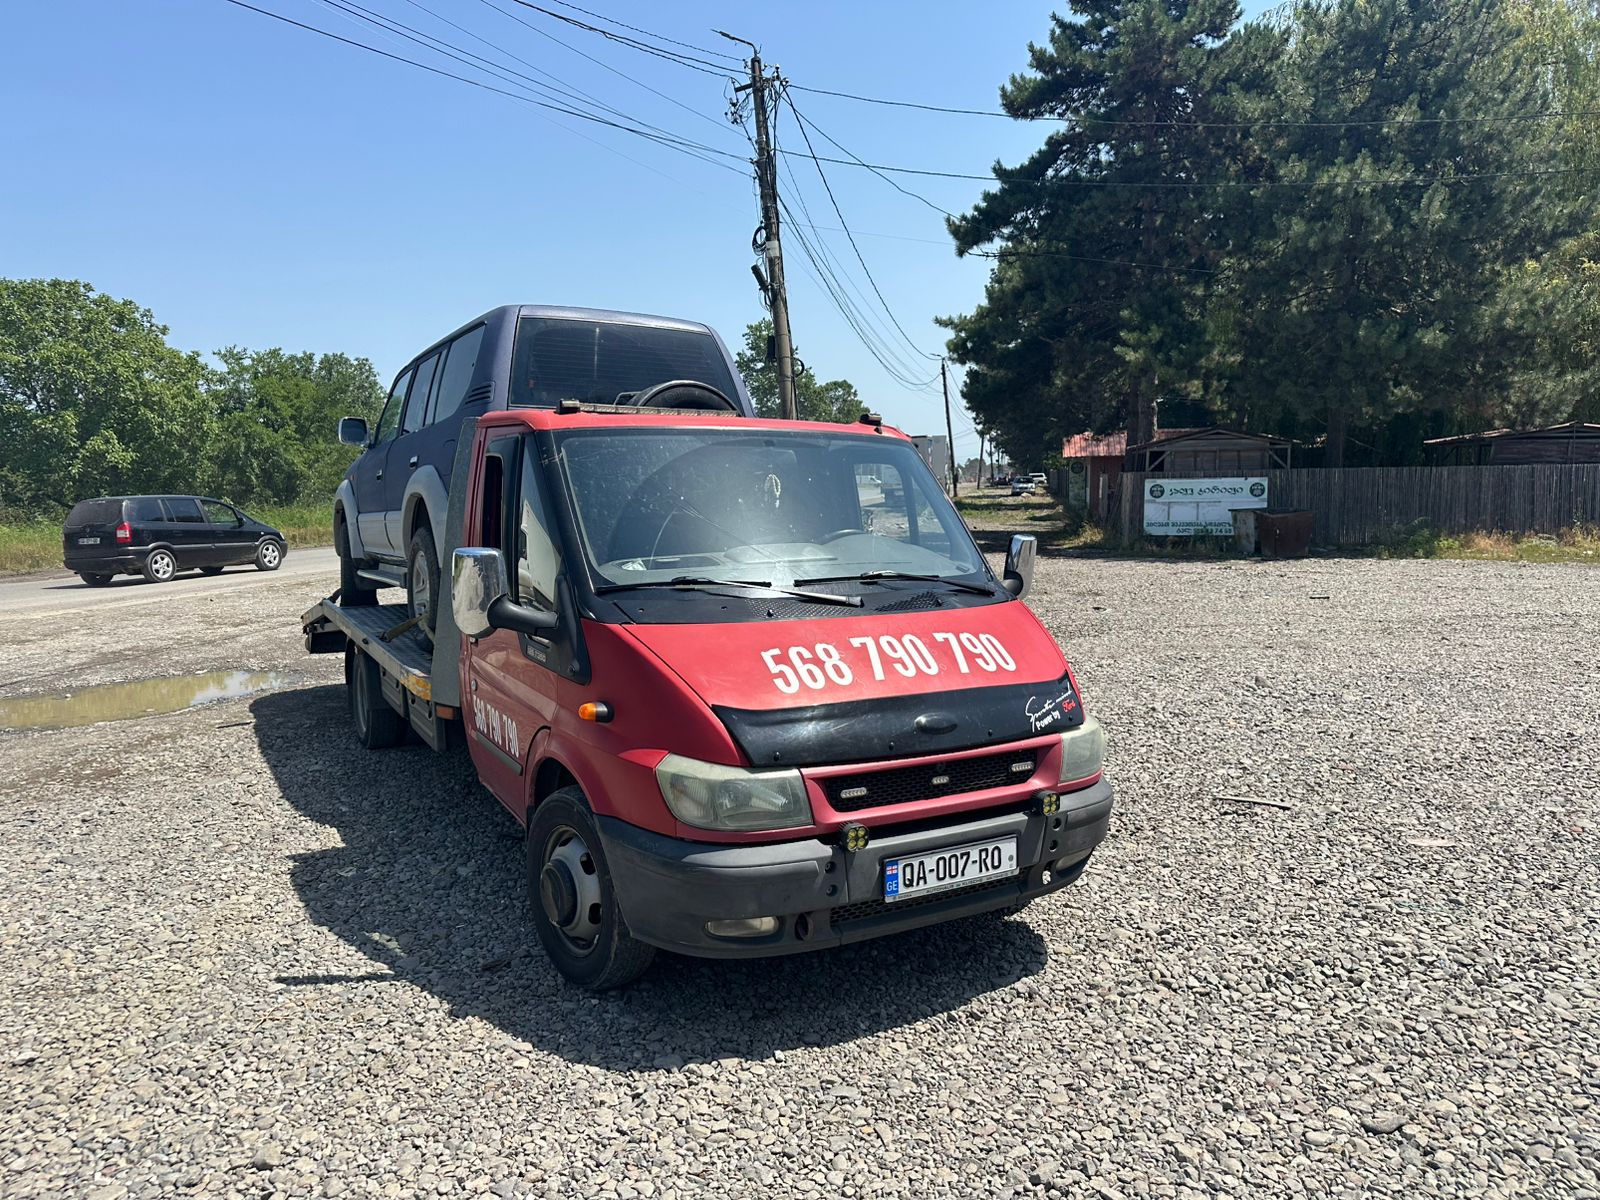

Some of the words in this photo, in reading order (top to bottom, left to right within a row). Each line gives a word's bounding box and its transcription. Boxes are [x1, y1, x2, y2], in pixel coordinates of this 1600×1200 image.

[761, 643, 854, 694] 568
[849, 634, 939, 681] 790
[937, 632, 1016, 673] 790
[473, 694, 487, 735] 568
[486, 703, 502, 746] 790
[502, 714, 519, 758] 790
[1035, 713, 1054, 731] Power
[1051, 709, 1061, 720] by
[886, 879, 898, 892] GE
[903, 845, 1002, 888] QA-007-RO
